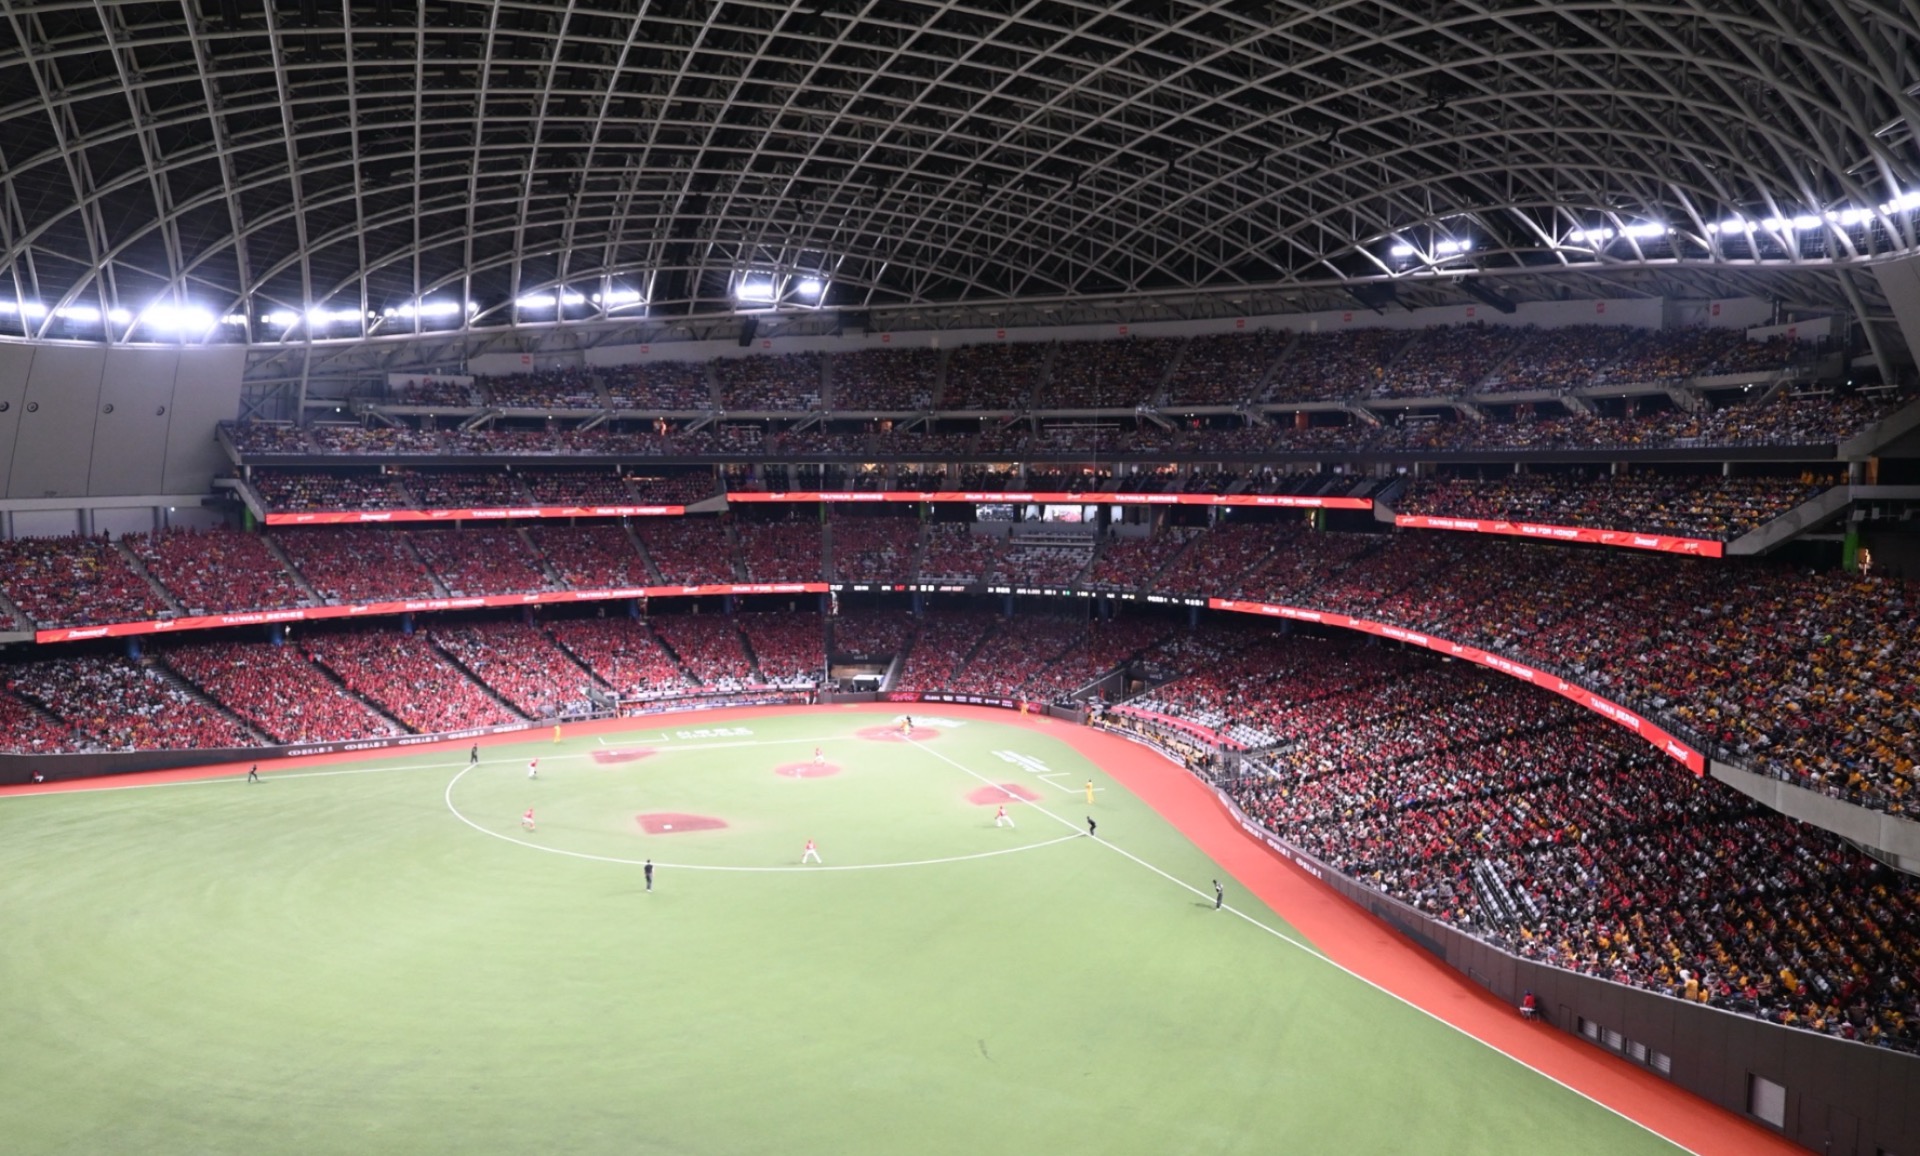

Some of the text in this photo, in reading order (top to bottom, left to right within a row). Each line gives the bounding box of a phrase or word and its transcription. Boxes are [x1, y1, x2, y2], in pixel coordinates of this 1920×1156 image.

[222, 610, 304, 623] TAIWAN SERIES
[1591, 697, 1639, 728] TAIWAN SERIES
